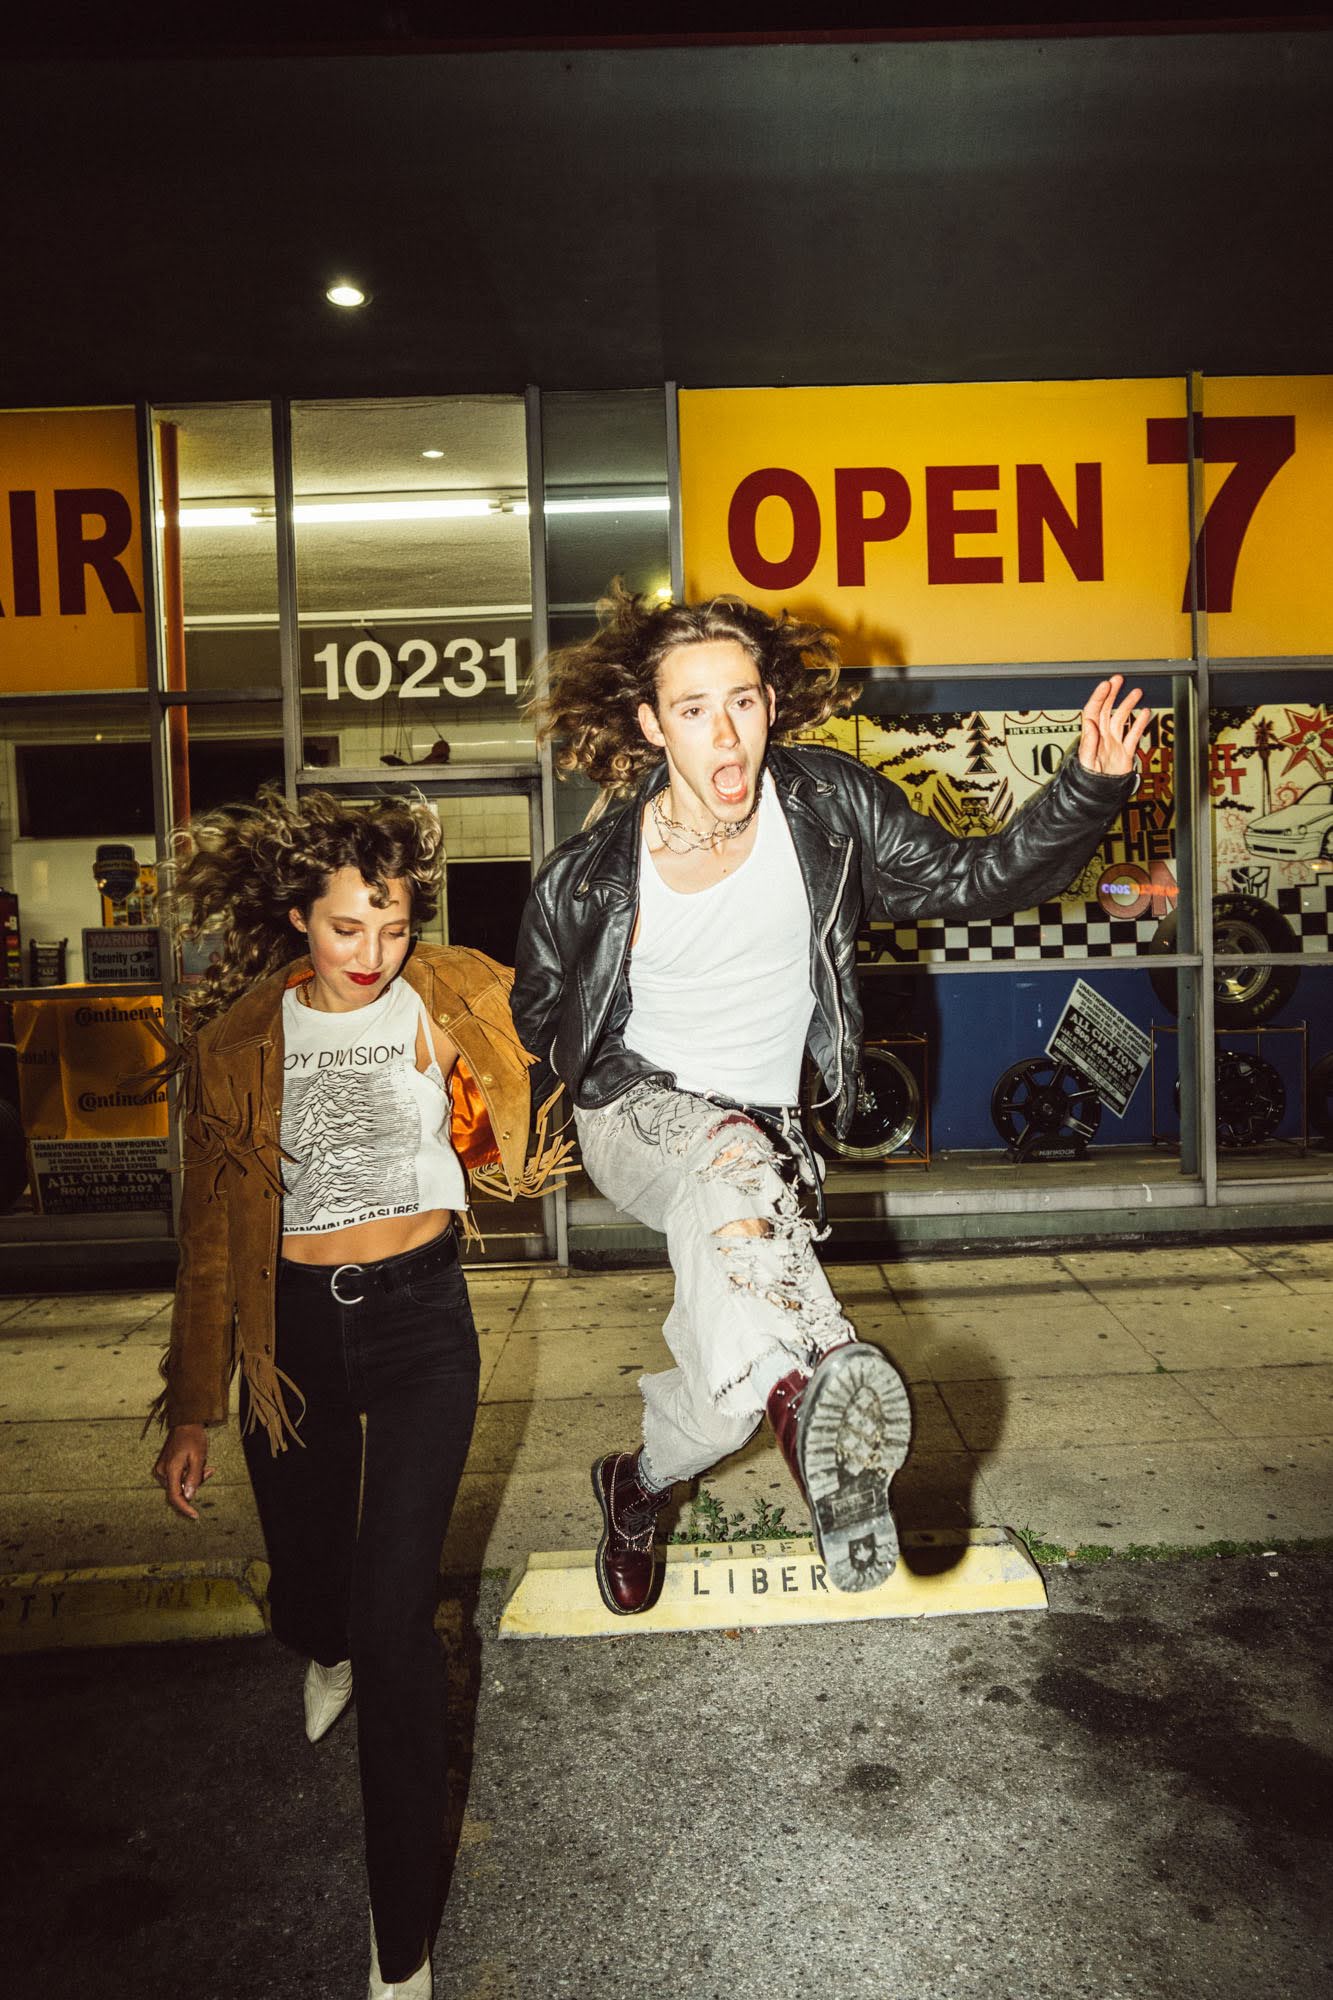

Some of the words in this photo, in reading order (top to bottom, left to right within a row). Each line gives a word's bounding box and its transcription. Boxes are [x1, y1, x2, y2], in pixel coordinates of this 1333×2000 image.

[728, 462, 1104, 590] OPEN
[1146, 415, 1295, 612] 7
[0, 488, 142, 617] IR
[314, 638, 517, 700] 10231
[1009, 725, 1080, 735] INTERSTATE
[1032, 743, 1065, 775] 10
[92, 952, 128, 965] Security
[92, 966, 128, 978] Cameras
[1069, 1009, 1092, 1034] ALL
[1090, 1026, 1115, 1053] CITY
[1114, 1048, 1138, 1075] TOW
[1072, 1024, 1128, 1078] 800/498-0202
[283, 1053, 314, 1070] OY
[47, 1174, 78, 1188] ALL
[81, 1172, 122, 1184] CITY
[127, 1172, 164, 1184] TOW
